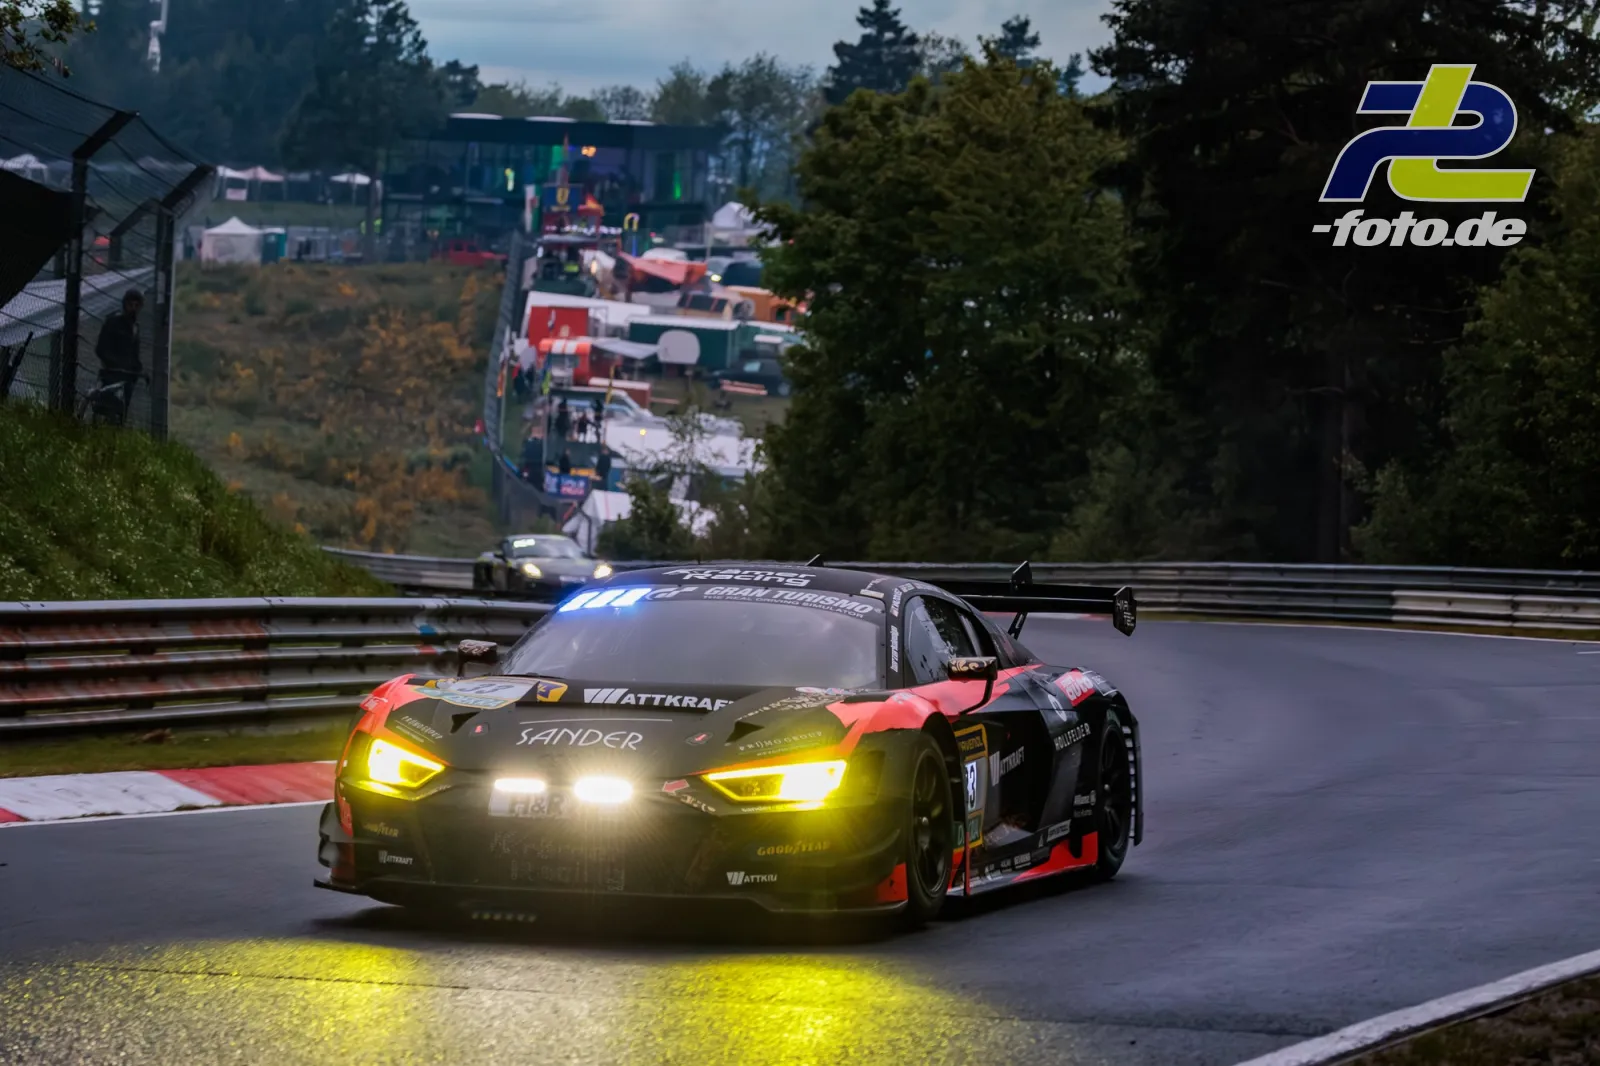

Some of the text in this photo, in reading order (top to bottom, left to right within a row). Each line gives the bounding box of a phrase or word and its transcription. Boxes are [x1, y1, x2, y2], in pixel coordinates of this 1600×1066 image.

[682, 573, 811, 587] Racing
[703, 586, 773, 599] GRAN
[774, 589, 873, 614] TURISMO
[755, 597, 800, 606] DRIVING
[802, 601, 864, 619] SIMULATOR
[583, 688, 734, 711] WATTKRAF
[515, 728, 643, 751] SANDER
